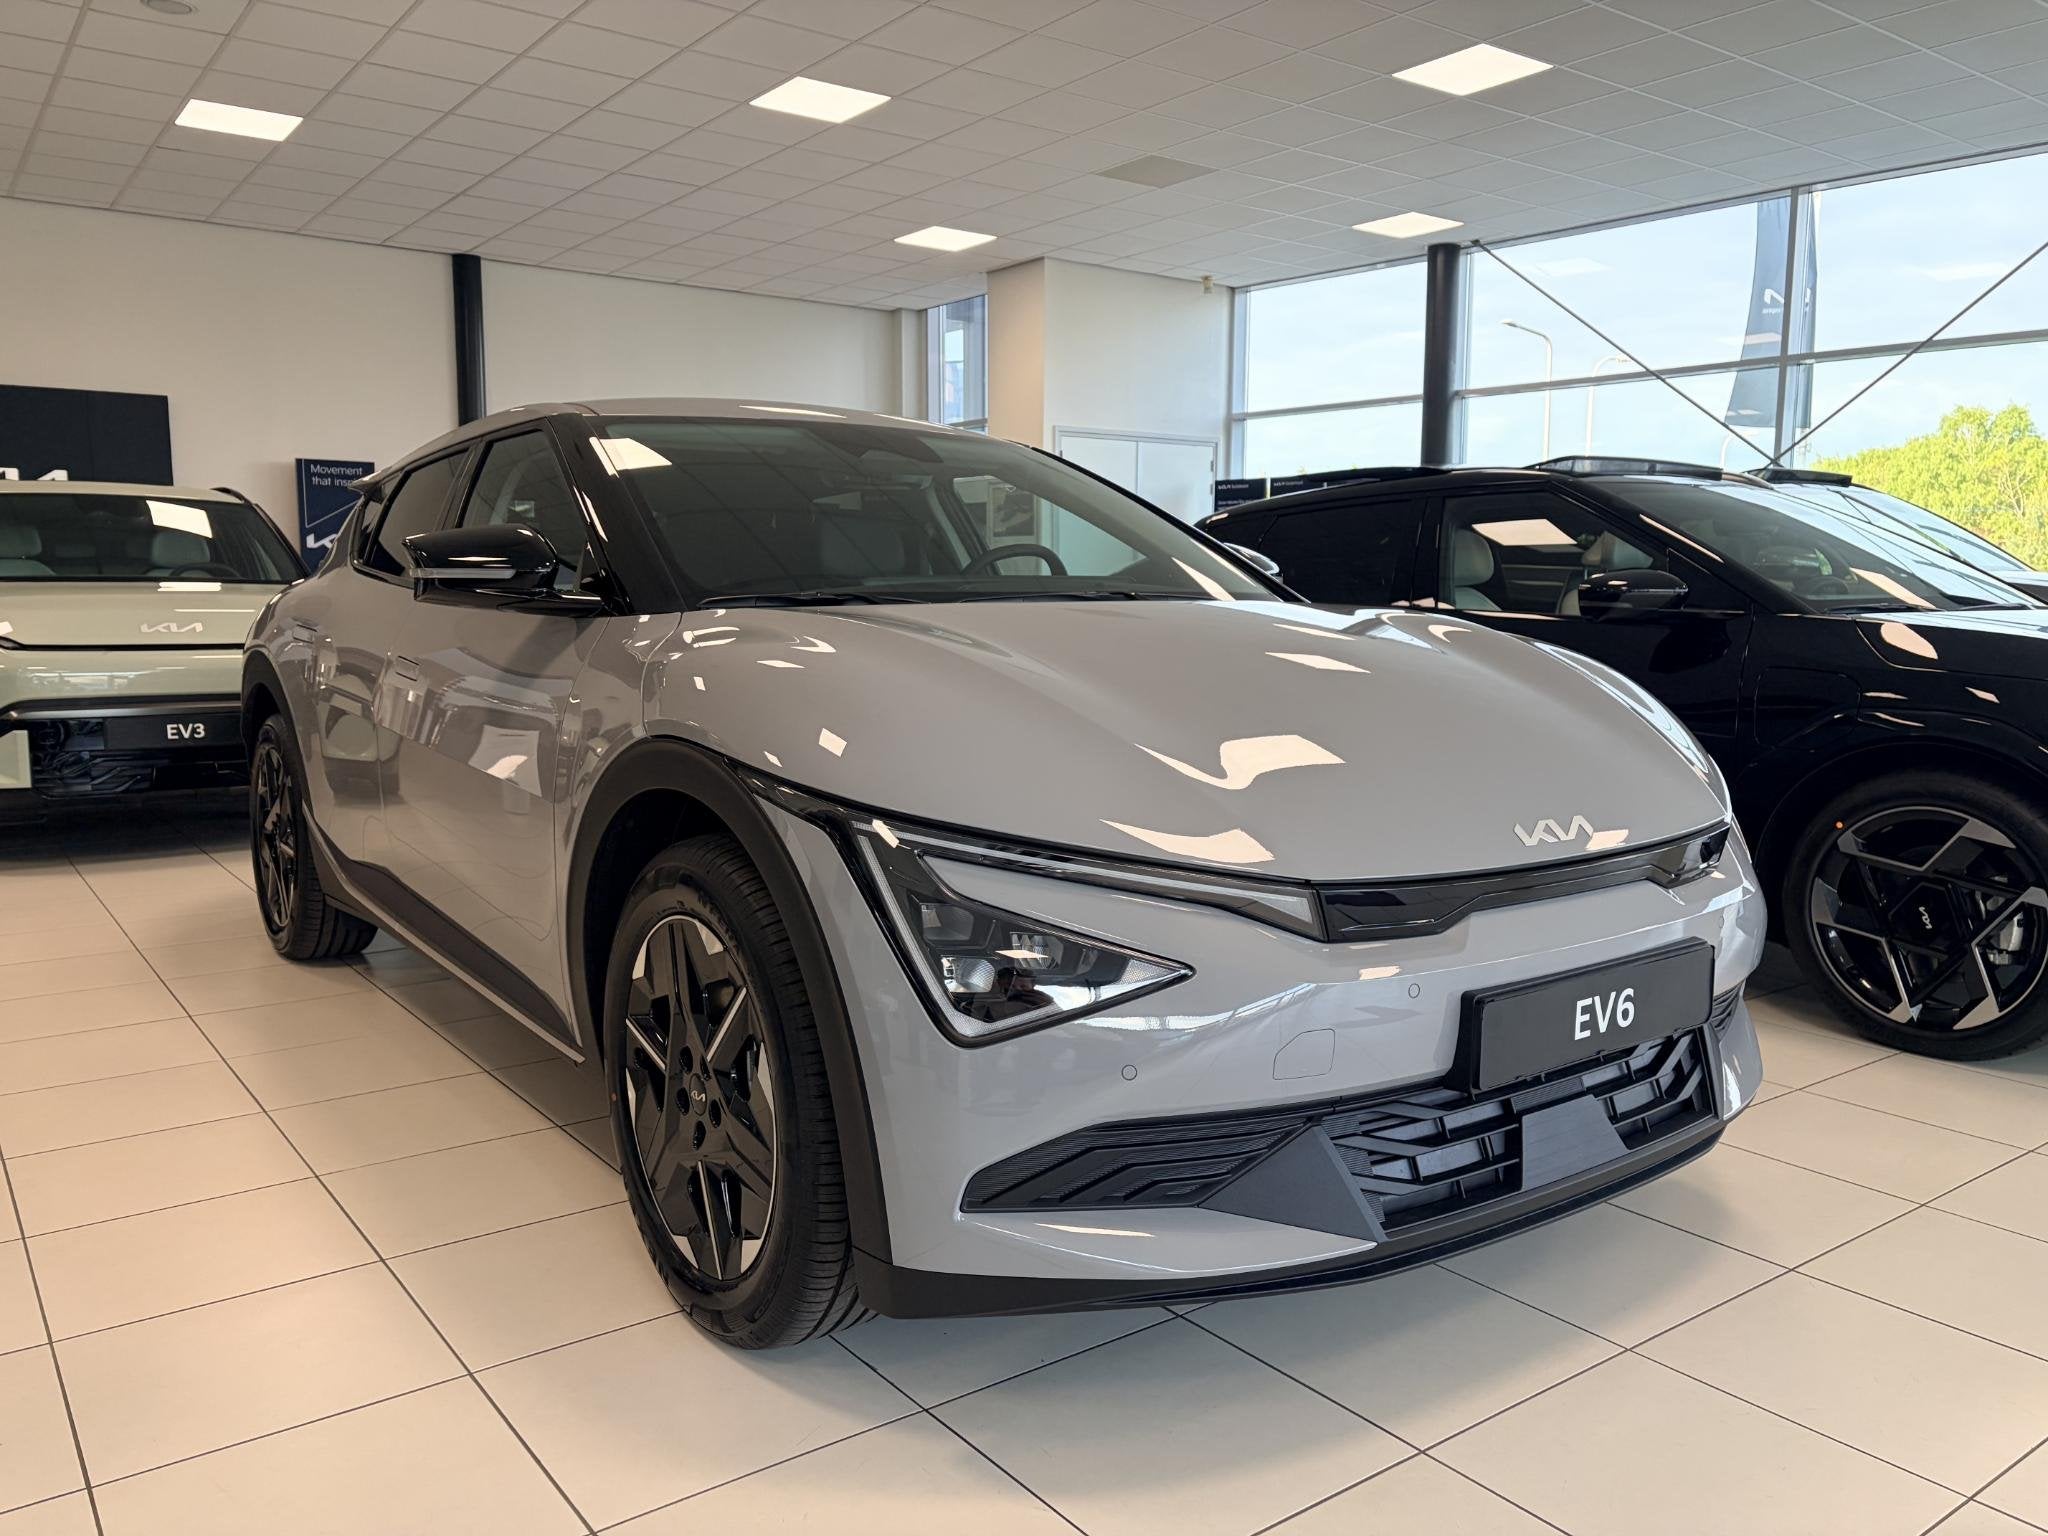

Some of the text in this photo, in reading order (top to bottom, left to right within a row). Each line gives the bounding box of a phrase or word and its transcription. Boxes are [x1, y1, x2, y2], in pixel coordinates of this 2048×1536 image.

[310, 463, 363, 476] Movement
[312, 476, 331, 487] that
[166, 723, 206, 740] EV3
[1574, 988, 1635, 1041] EV6
